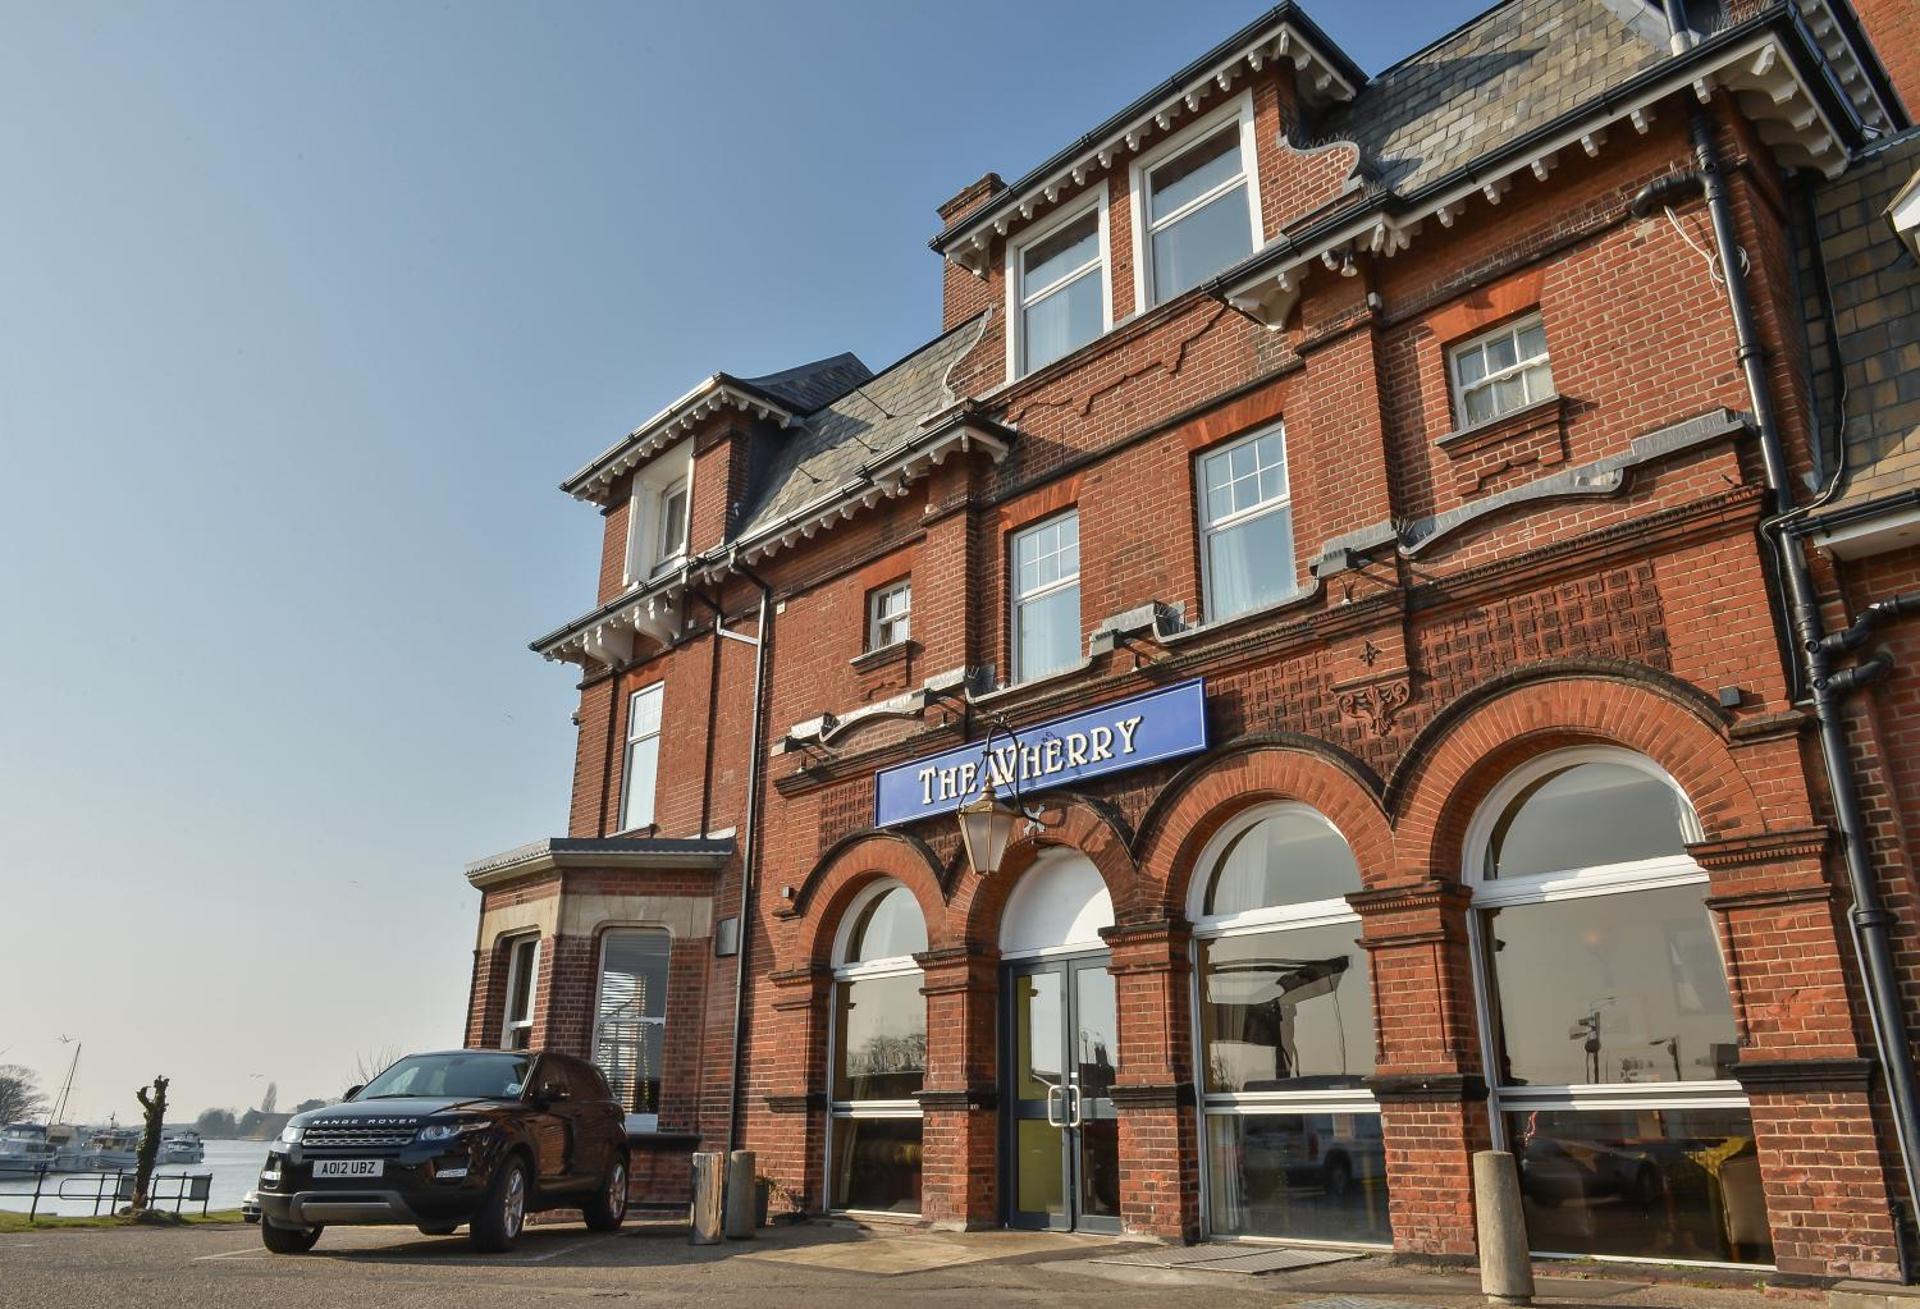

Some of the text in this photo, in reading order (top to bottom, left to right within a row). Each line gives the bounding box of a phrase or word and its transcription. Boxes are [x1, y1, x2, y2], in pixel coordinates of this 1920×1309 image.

[918, 716, 1142, 805] THE WHERRY
[312, 1117, 418, 1126] RANGE ROVER
[352, 1161, 376, 1174] UBZ
